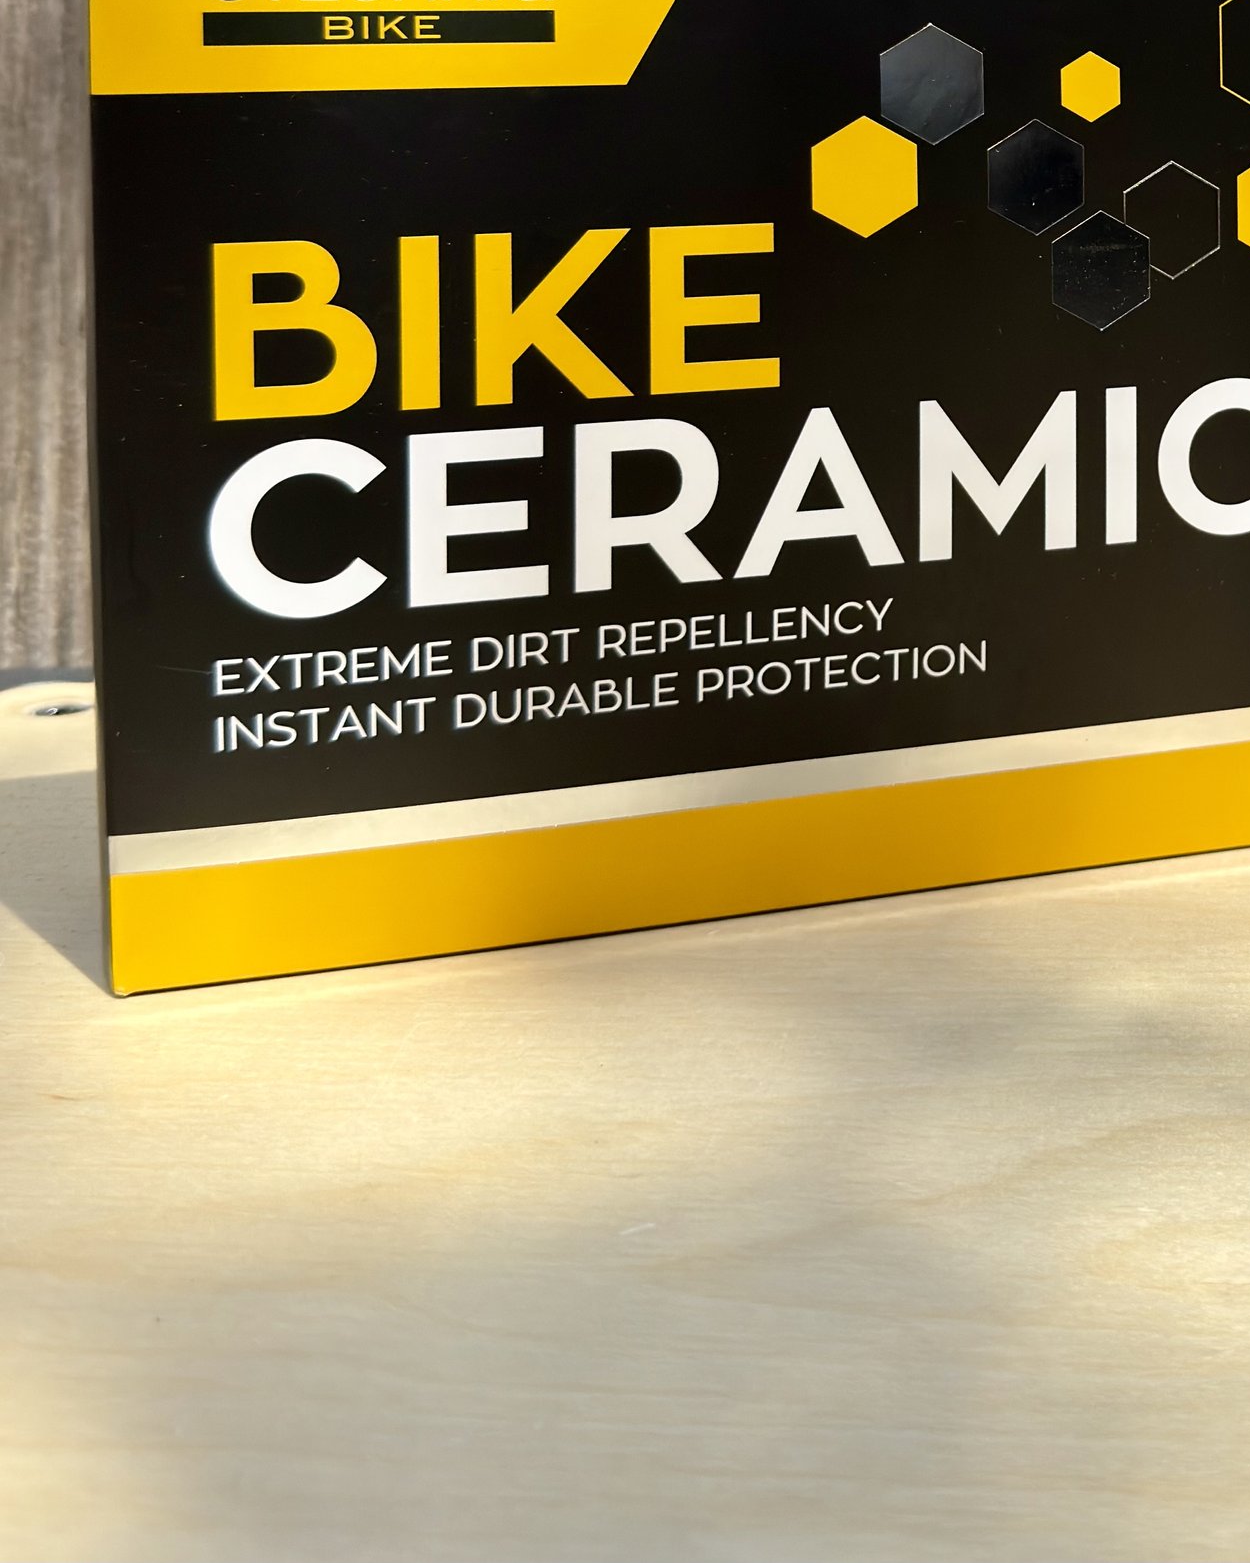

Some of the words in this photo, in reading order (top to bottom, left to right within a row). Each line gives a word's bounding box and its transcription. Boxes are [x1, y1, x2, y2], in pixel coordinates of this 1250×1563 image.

[322, 15, 442, 40] BIKE
[213, 223, 781, 421] BIKE
[212, 697, 437, 753] INSTANT
[454, 672, 679, 729] DURABLE
[697, 640, 988, 704] PROTECTION
[213, 640, 453, 696] EXTREME
[470, 628, 580, 674] DIRT
[597, 598, 894, 660] REPELLENCY
